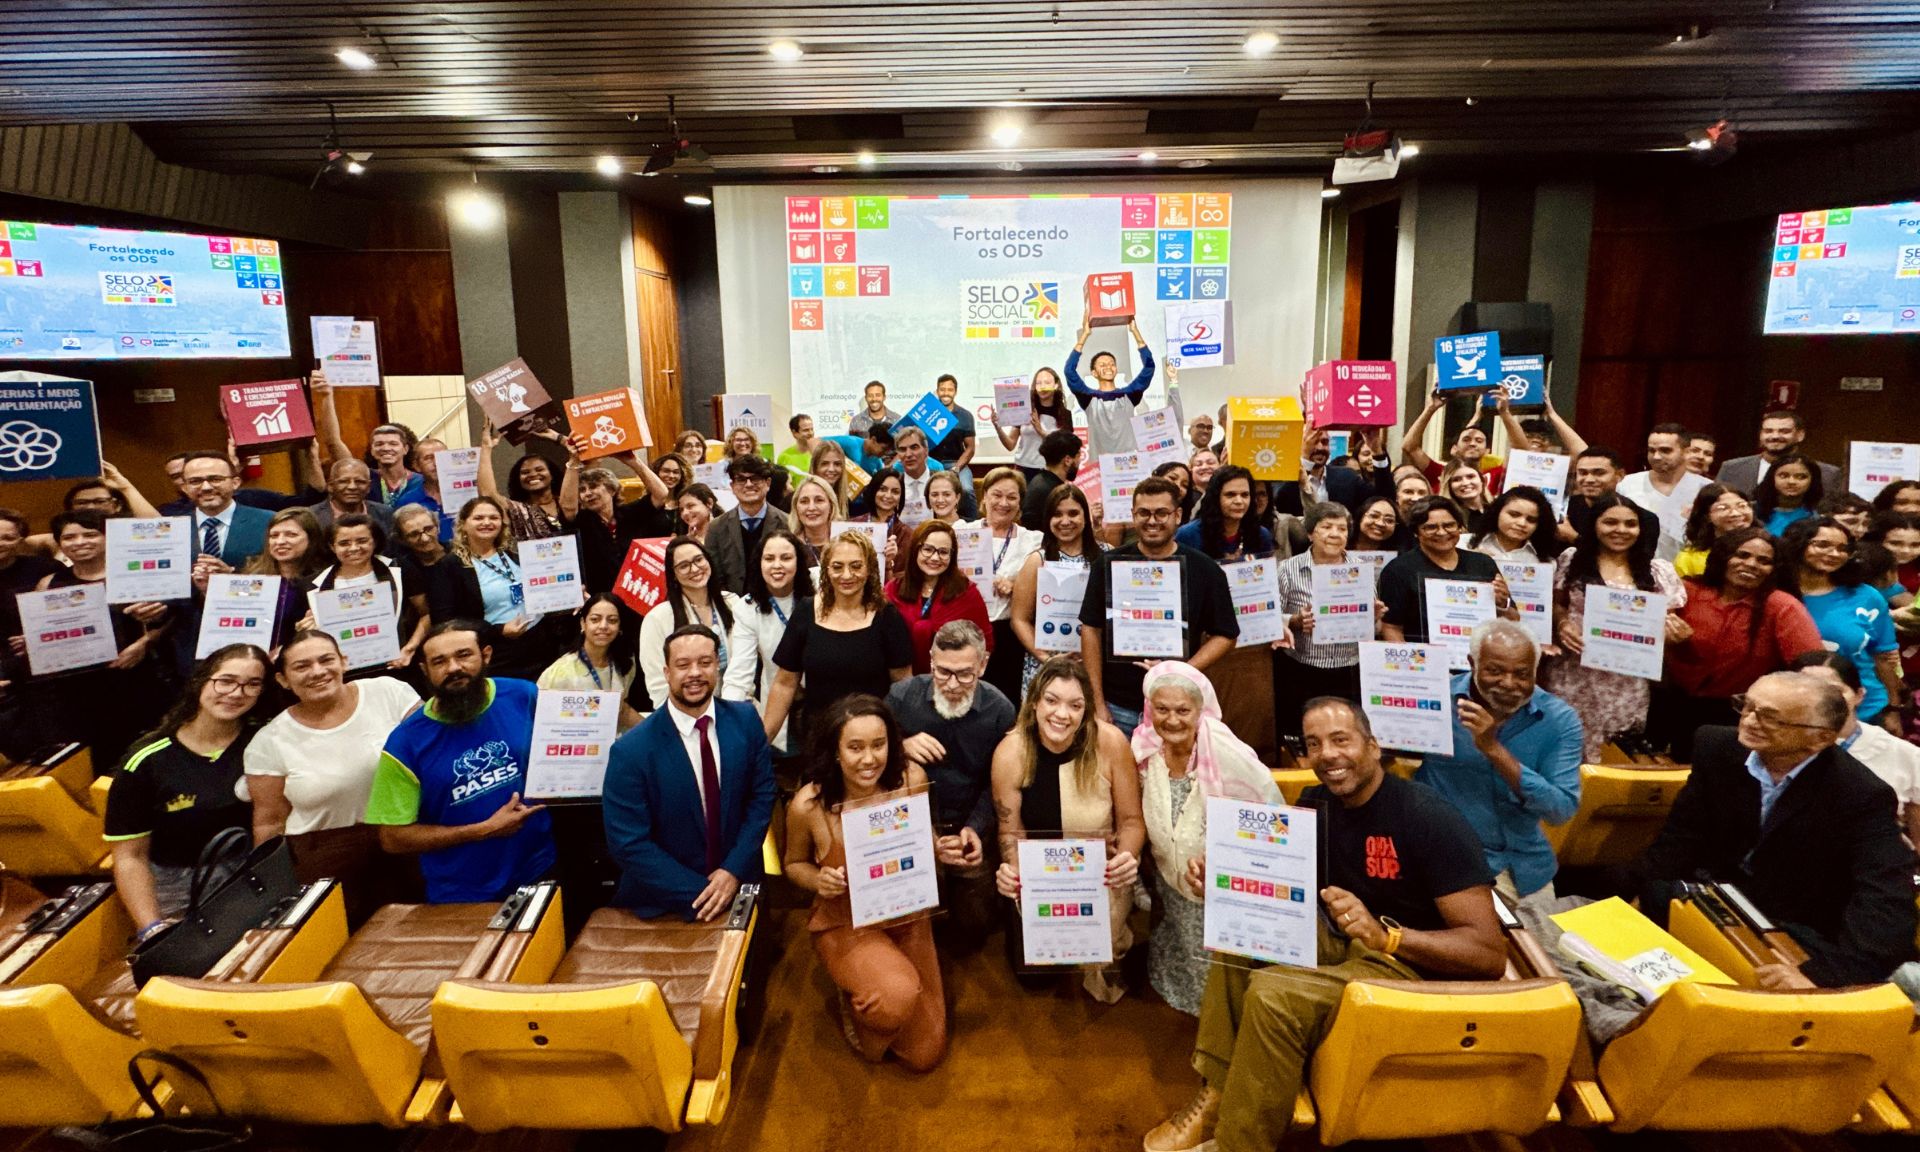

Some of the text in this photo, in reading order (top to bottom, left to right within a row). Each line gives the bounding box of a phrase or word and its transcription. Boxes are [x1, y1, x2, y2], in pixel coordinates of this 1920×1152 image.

[953, 225, 1069, 241] Fortalecendo
[89, 243, 175, 256] Fortalecendo
[978, 243, 1043, 258] os ODS
[128, 254, 159, 264] ODS
[105, 274, 144, 286] SELO
[1093, 276, 1099, 287] 4
[106, 285, 151, 293] SOCIAL
[968, 285, 1020, 304] SELO
[968, 304, 1028, 319] SOCIAL
[1440, 341, 1453, 353] 16
[1336, 365, 1350, 380] 10
[38, 390, 45, 398] E
[47, 388, 81, 398] MEIOS
[471, 380, 488, 396] 18
[230, 389, 242, 403] 8
[570, 403, 580, 417] 9
[819, 415, 840, 424] SELO
[1240, 425, 1247, 438] 7
[632, 548, 639, 561] 1
[1132, 567, 1149, 575] SELO
[1384, 648, 1408, 658] SELO
[562, 696, 585, 705] SELO
[452, 762, 519, 801] PASES
[868, 809, 892, 822] SELO
[1238, 808, 1268, 823] SELO
[1239, 820, 1271, 832] SOCIAL
[1044, 848, 1068, 857] SELO
[1366, 857, 1400, 879] SUP
